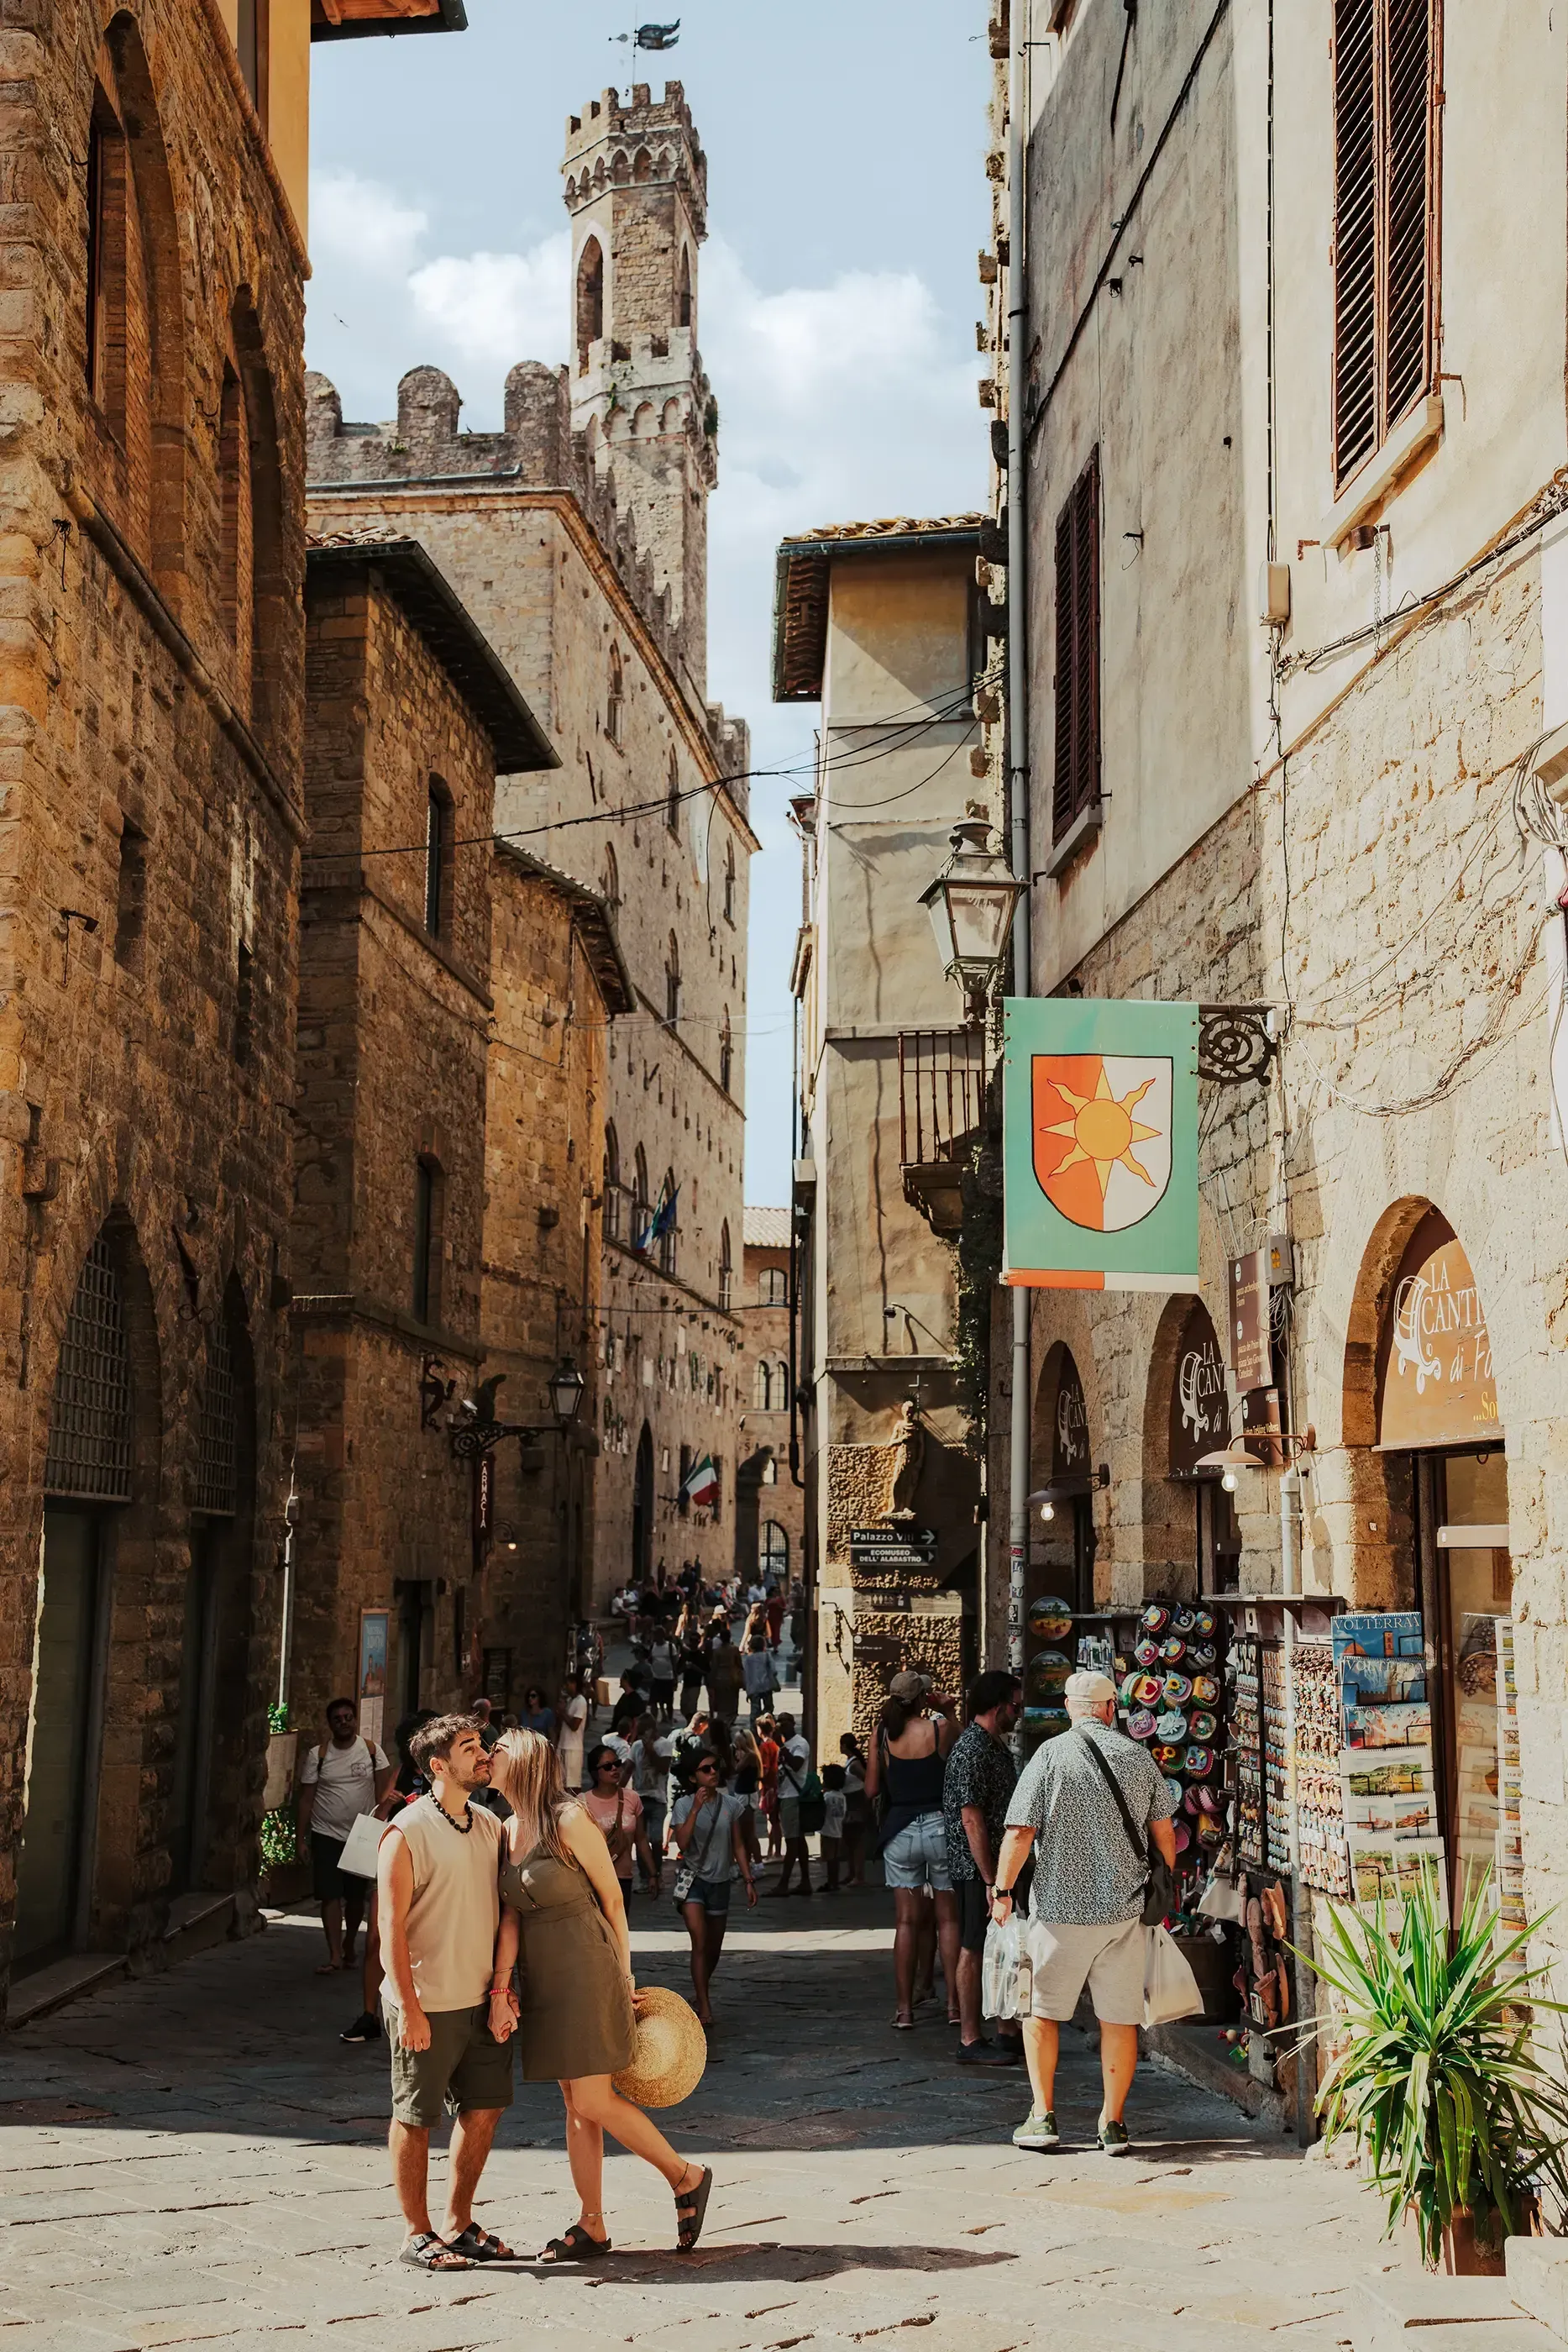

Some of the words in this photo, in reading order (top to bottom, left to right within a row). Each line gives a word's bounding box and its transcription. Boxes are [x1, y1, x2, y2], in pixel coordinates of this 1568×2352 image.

[1430, 1261, 1450, 1293] LA
[1203, 1341, 1215, 1366] LA
[1450, 1346, 1464, 1383] di
[853, 1532, 894, 1541] Palazzo
[896, 1533, 914, 1541] Viti
